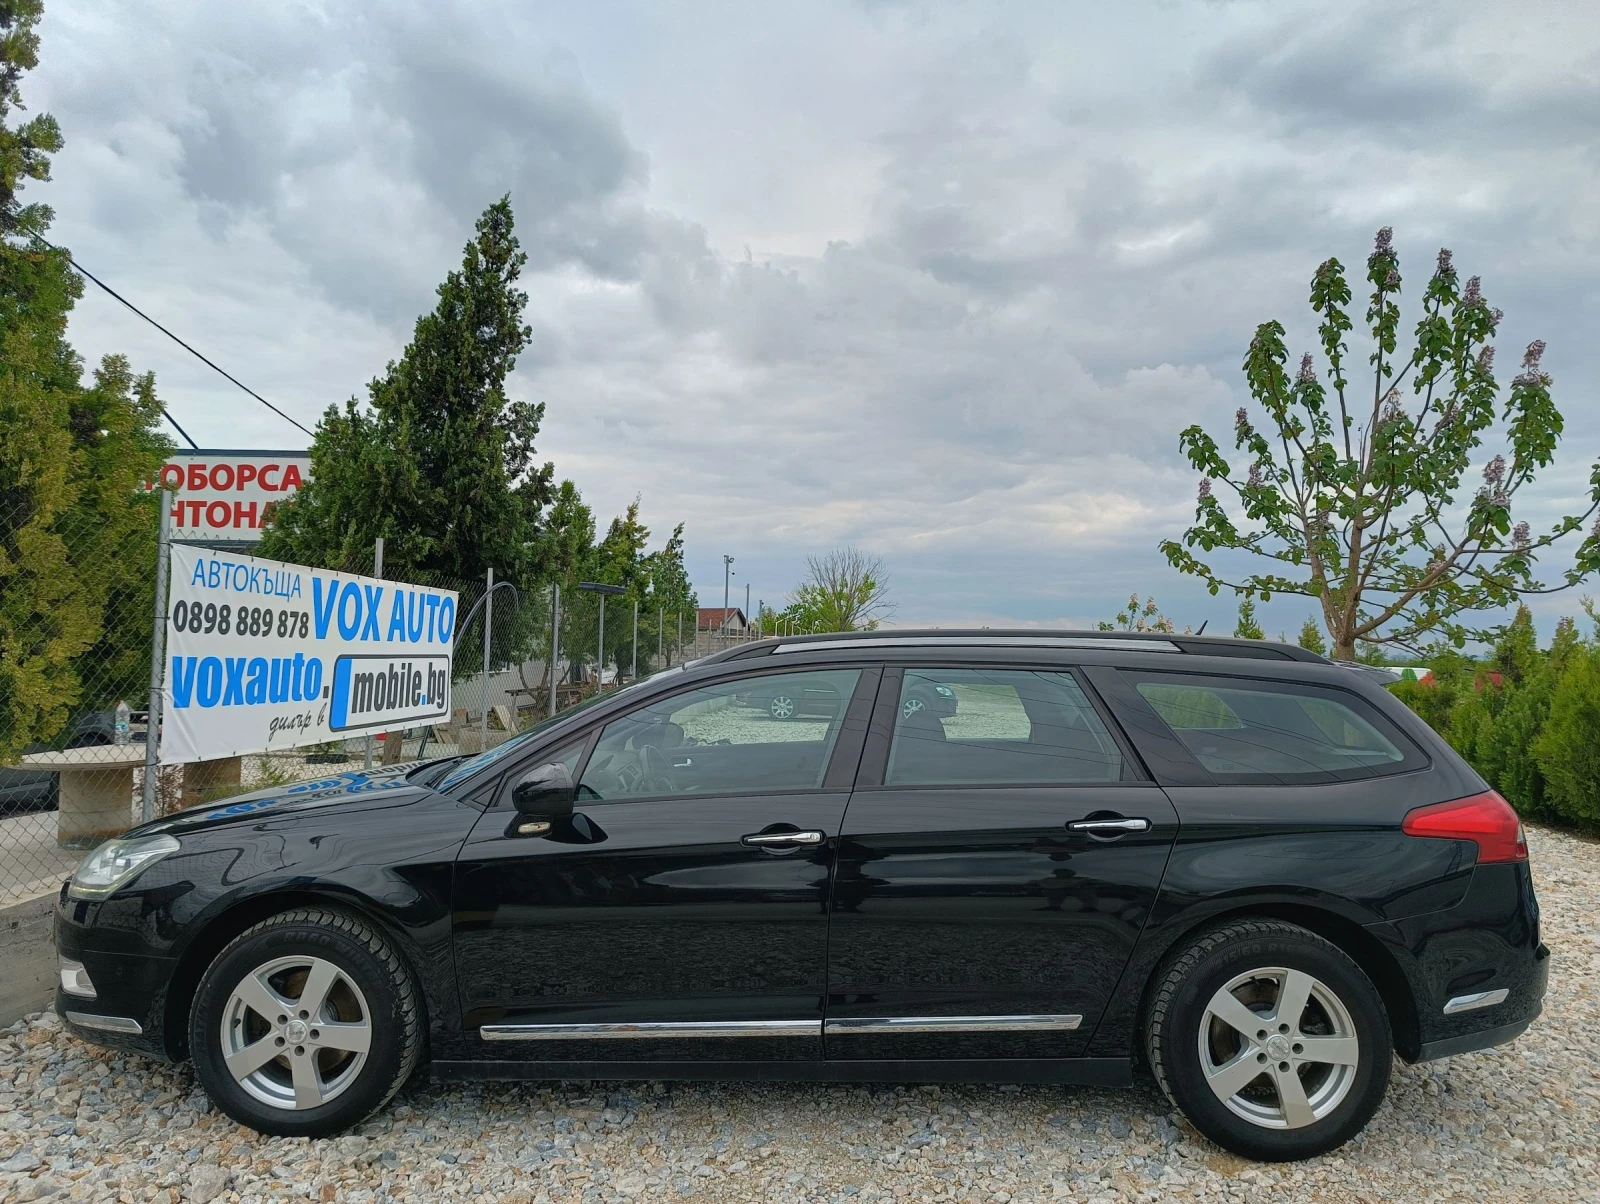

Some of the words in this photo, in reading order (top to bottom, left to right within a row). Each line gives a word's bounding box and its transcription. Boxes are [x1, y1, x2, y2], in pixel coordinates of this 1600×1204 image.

[191, 558, 302, 602] АВТОКЪЩА
[172, 600, 231, 635] 0898
[235, 606, 274, 638] 889
[276, 611, 310, 640] 878
[311, 577, 384, 642] VOX
[386, 590, 455, 644] AUTO
